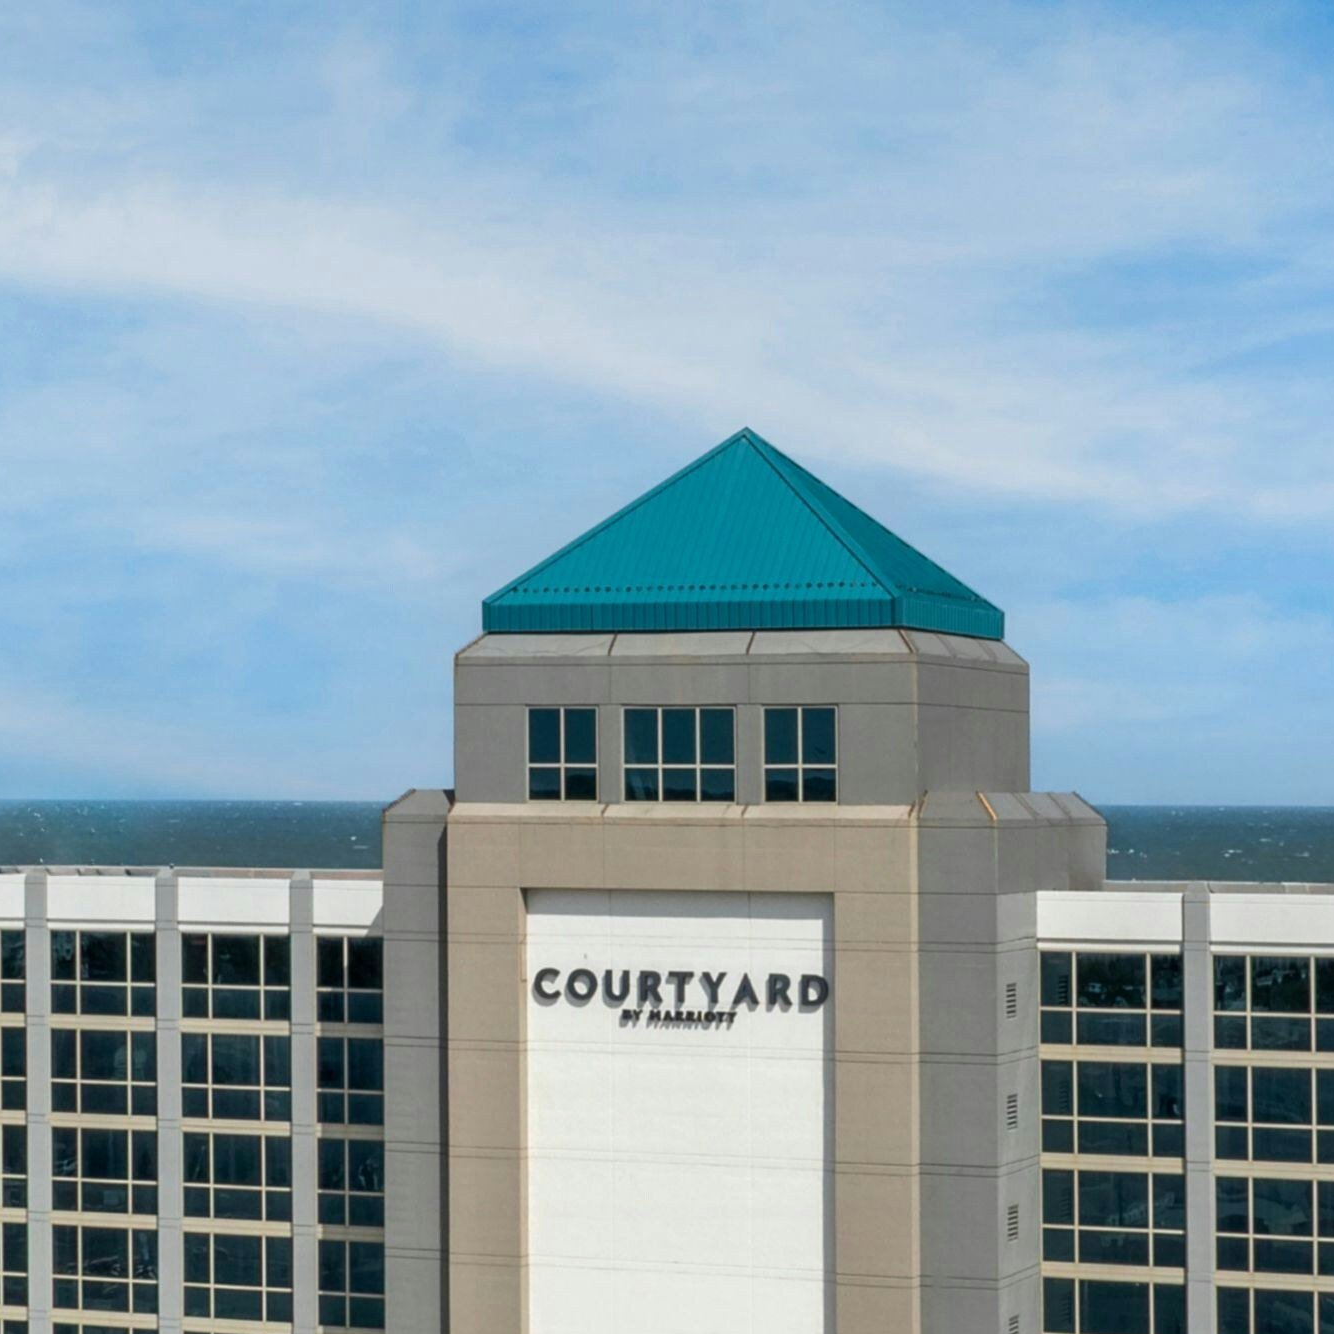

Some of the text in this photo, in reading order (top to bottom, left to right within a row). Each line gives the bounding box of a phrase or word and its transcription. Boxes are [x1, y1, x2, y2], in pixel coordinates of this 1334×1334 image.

[533, 967, 830, 1008] COURTYARD
[621, 1009, 737, 1024] BY MARRIOTT
